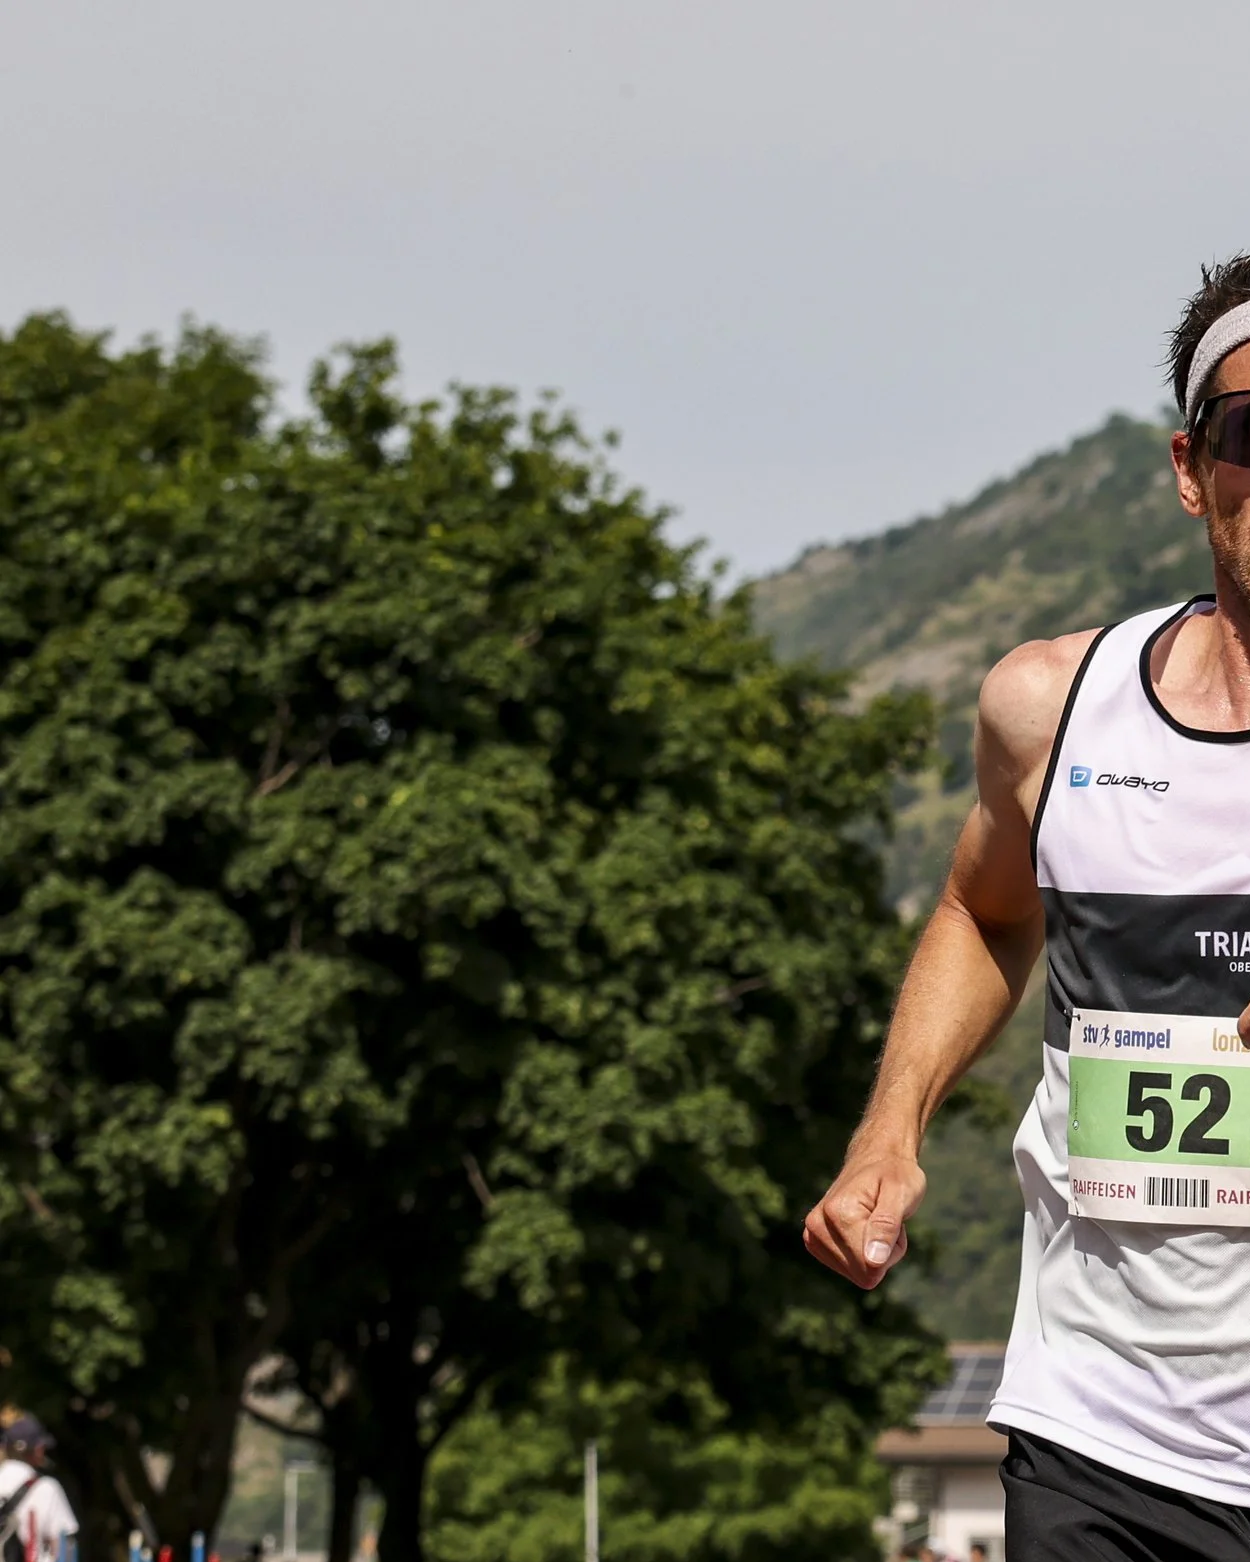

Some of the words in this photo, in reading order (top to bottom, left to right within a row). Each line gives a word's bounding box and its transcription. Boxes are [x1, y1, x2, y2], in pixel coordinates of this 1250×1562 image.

[1096, 772, 1170, 793] owayo
[1083, 1024, 1098, 1044] stv
[1114, 1028, 1171, 1050] gampel
[1125, 1070, 1231, 1156] 52
[1073, 1178, 1136, 1200] RAIFFEISEN
